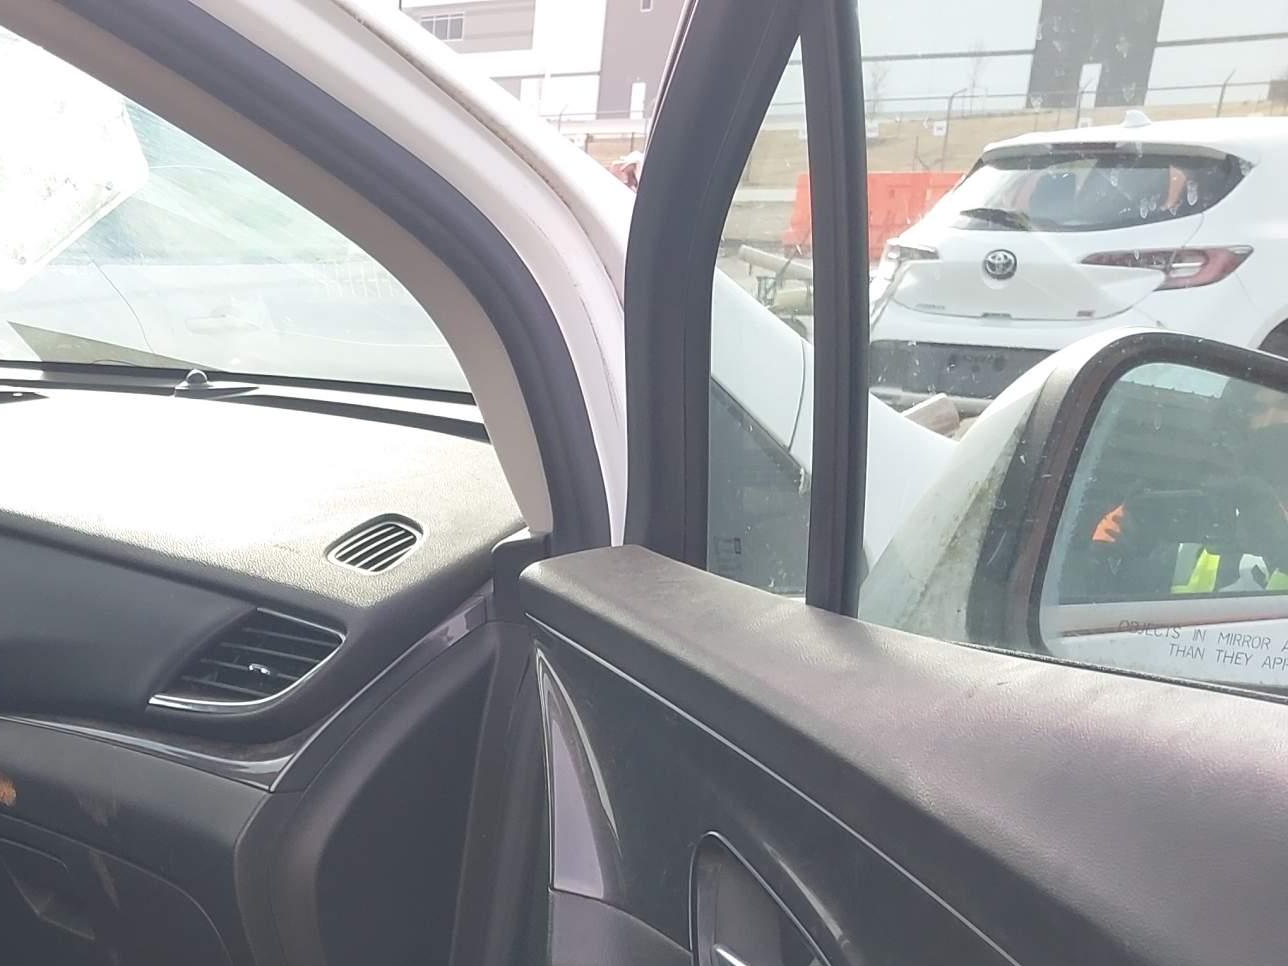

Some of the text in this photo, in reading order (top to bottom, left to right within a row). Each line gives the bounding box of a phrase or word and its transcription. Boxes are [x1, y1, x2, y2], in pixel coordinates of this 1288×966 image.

[1118, 619, 1183, 640] OBJECTS
[1192, 628, 1208, 642] IN
[1217, 631, 1272, 650] MIRROR
[1168, 643, 1206, 661] THAN
[1215, 649, 1254, 666] THEY
